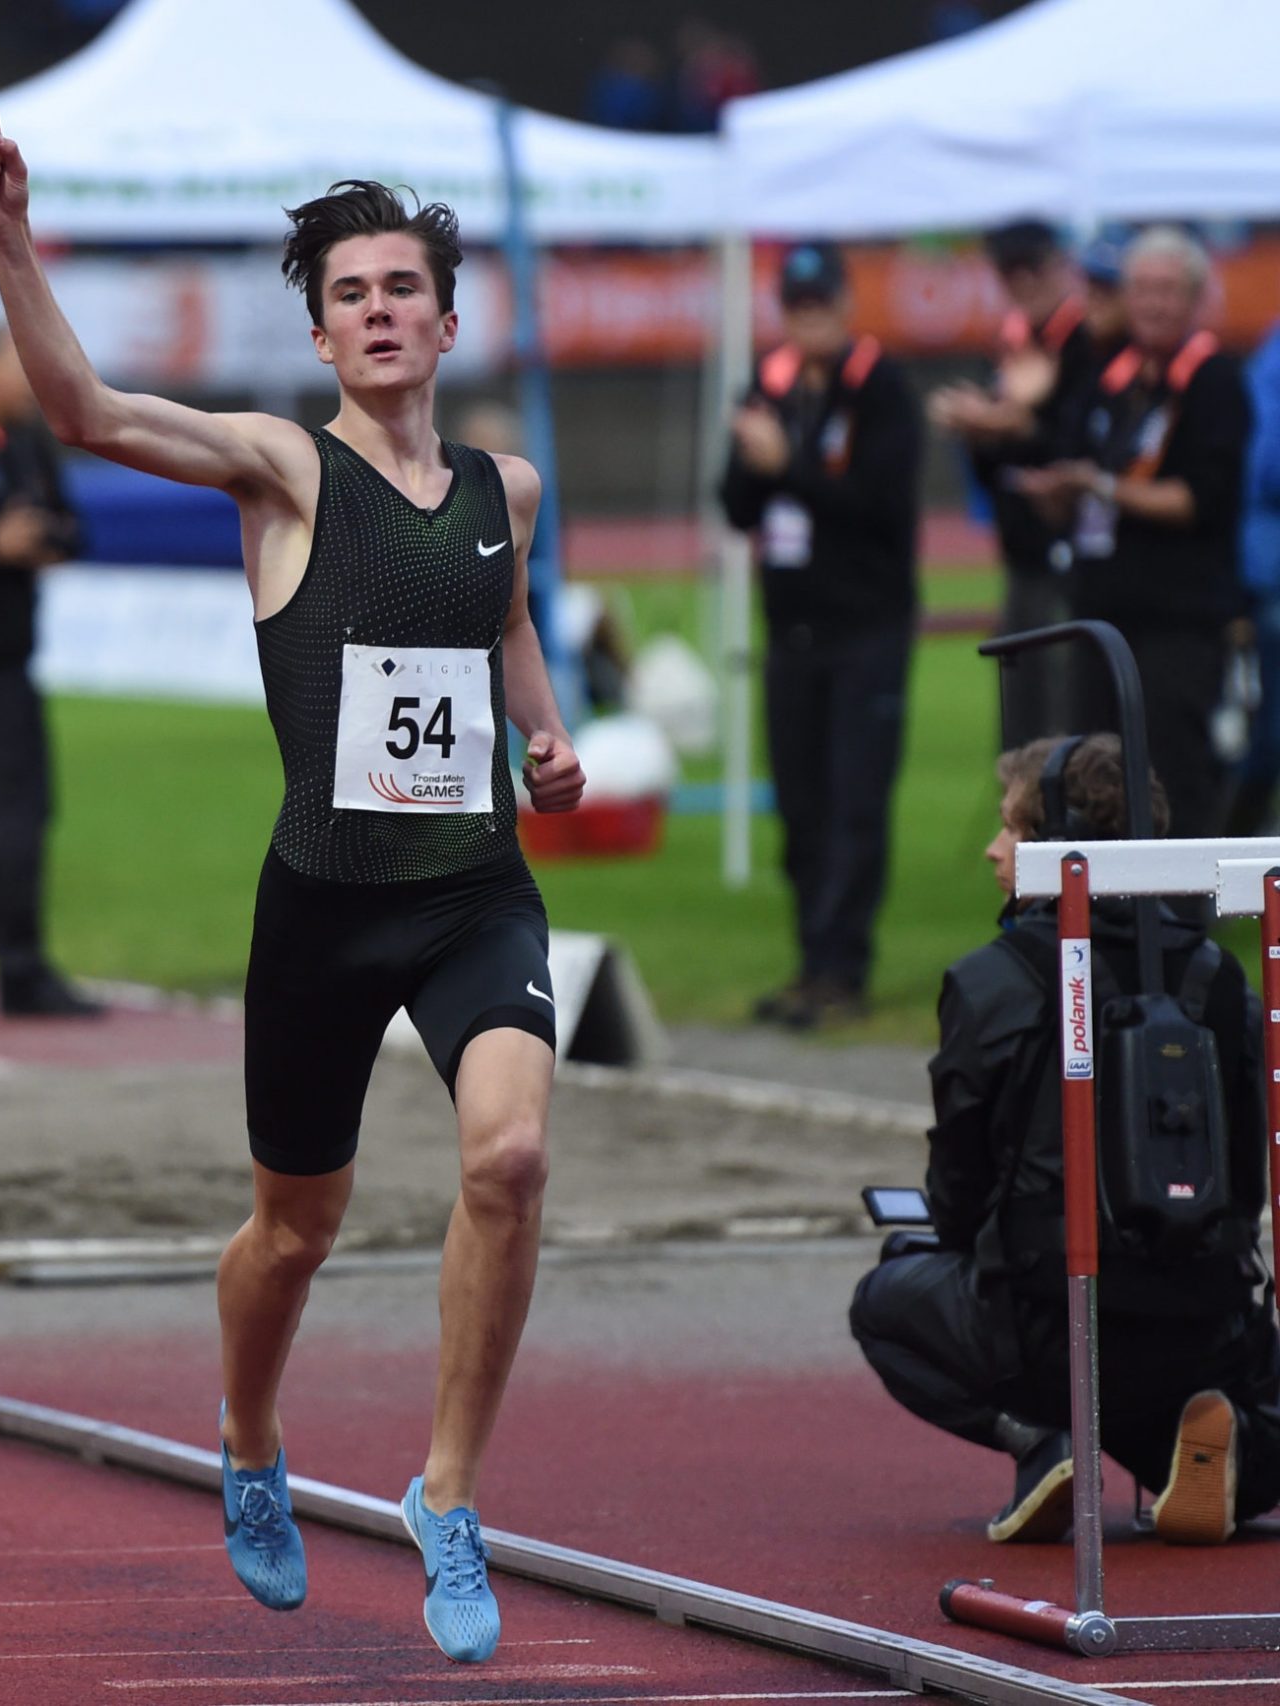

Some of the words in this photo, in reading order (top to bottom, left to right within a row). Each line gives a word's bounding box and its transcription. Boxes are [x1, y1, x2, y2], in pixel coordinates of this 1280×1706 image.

[385, 696, 456, 760] 54
[411, 784, 465, 798] GAMES
[412, 774, 440, 783] Trond
[442, 774, 466, 783] Mohn
[1068, 976, 1089, 1053] polanik
